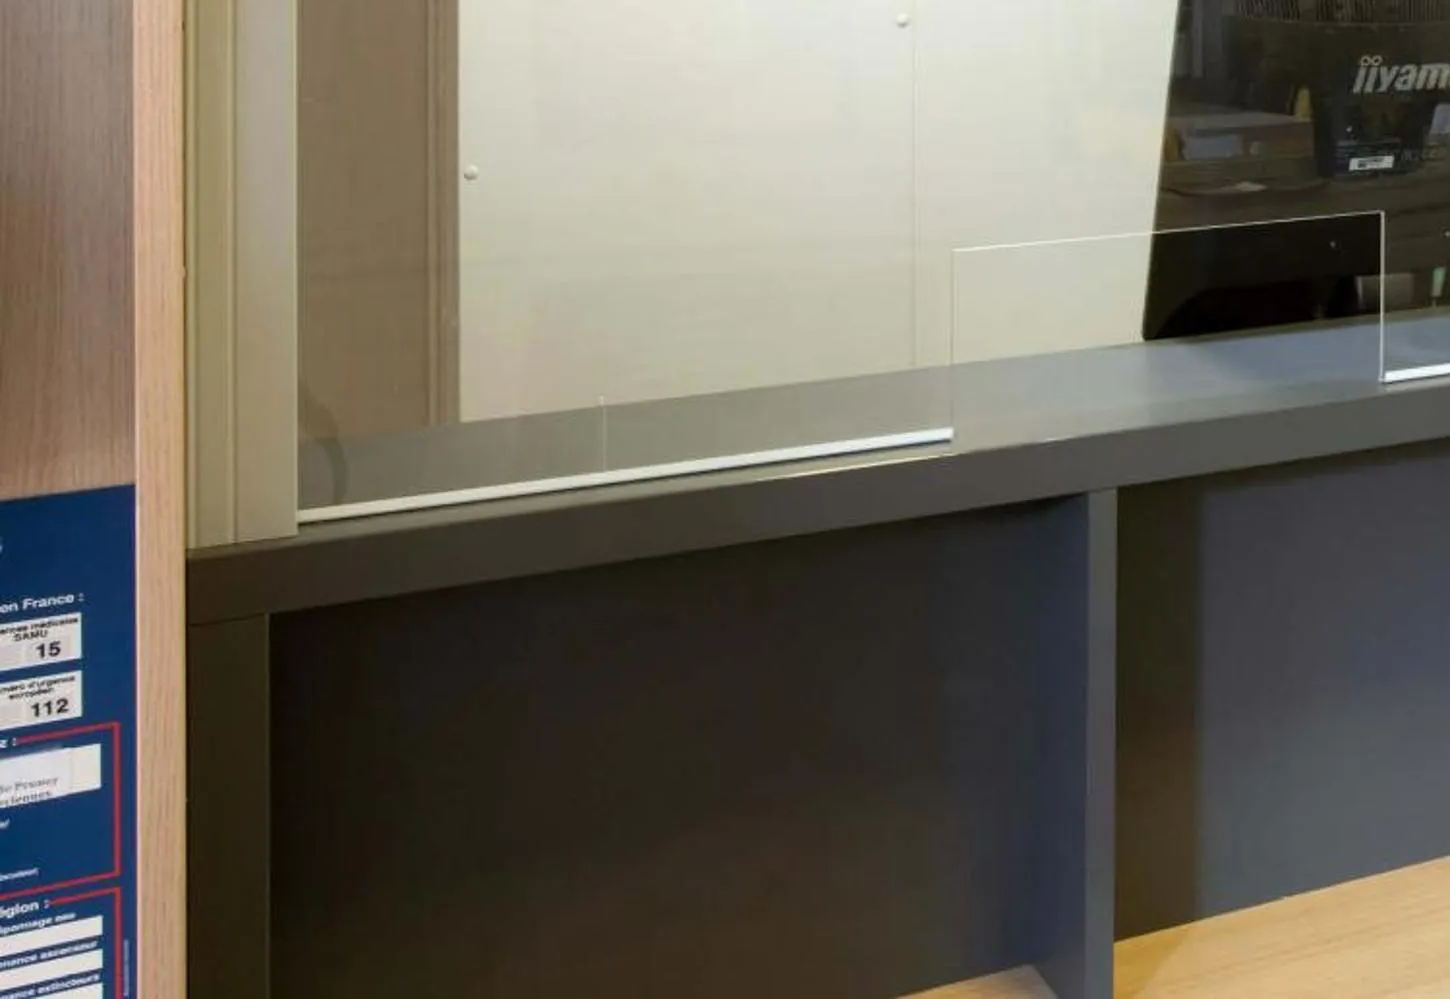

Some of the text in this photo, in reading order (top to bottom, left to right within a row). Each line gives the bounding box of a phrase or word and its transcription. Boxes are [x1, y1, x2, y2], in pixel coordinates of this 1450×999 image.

[22, 594, 75, 610] France
[13, 629, 48, 641] SAMU
[35, 641, 62, 659] 15
[31, 697, 69, 717] 112
